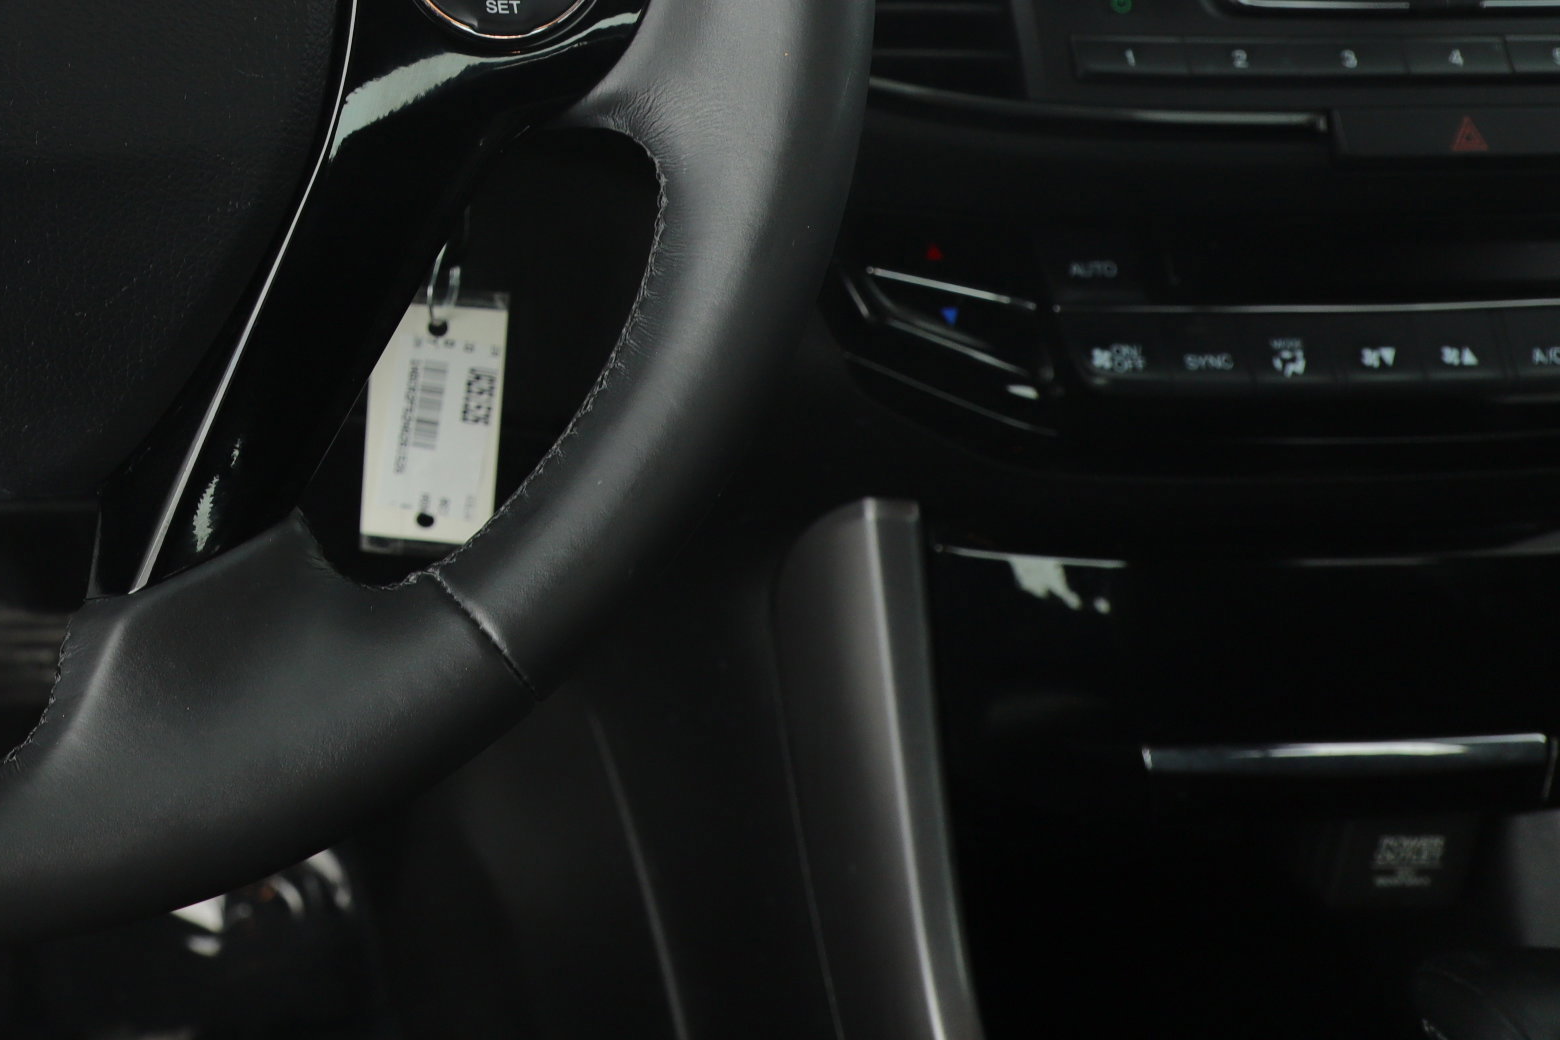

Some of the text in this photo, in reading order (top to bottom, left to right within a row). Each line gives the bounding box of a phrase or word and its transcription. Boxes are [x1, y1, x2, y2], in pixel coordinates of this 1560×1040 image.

[485, 0, 521, 15] SET
[1124, 48, 1136, 67] 1
[1230, 48, 1249, 69] 2
[1340, 48, 1358, 69] 3
[1448, 47, 1465, 68] 4
[1069, 261, 1118, 278] AUTO
[1183, 352, 1235, 371] SYNC
